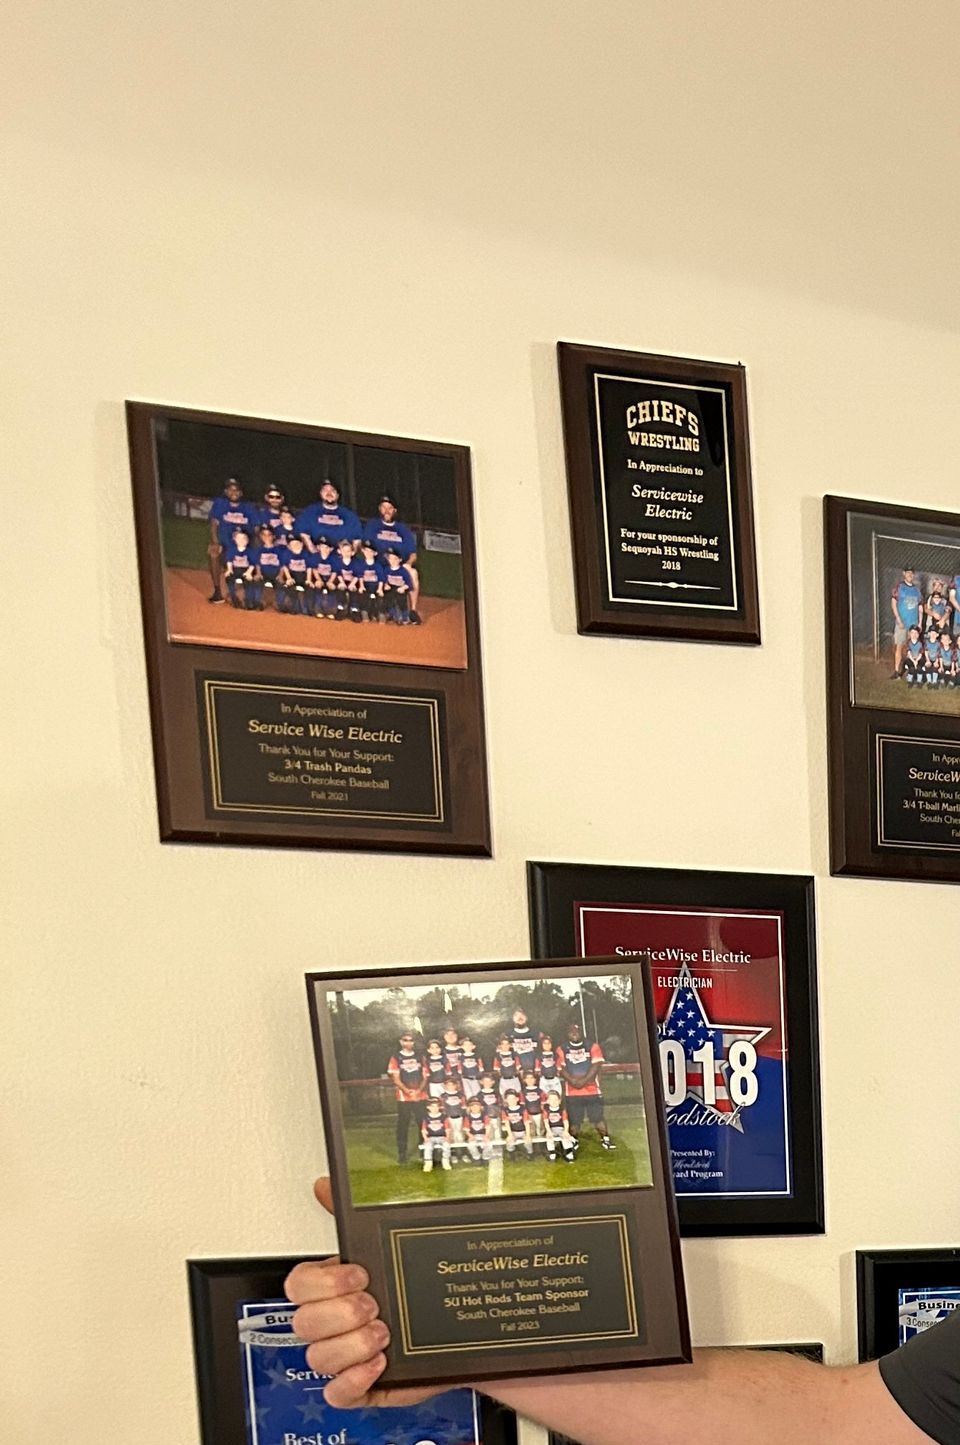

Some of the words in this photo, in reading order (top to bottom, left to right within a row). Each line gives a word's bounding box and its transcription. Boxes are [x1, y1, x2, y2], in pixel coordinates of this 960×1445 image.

[626, 400, 699, 436] CHIEFS
[628, 431, 699, 452] WRESTLING
[627, 459, 637, 468] In
[639, 460, 693, 475] Appreciation
[632, 484, 703, 503] Servicewise
[645, 504, 692, 520] Electric
[620, 528, 636, 538] For
[637, 531, 656, 540] your
[658, 532, 707, 546] sponsorship
[709, 537, 718, 545] of
[621, 543, 662, 555] Sequoyah
[664, 546, 677, 556] HS
[679, 548, 719, 561] Wrestling
[662, 561, 681, 570] 2018
[281, 703, 292, 713] In
[294, 704, 354, 719] Appreciation
[357, 710, 367, 719] of
[249, 720, 304, 736] Service
[309, 724, 343, 739] Wise
[349, 727, 402, 743] Electric
[259, 743, 290, 754] Thank
[293, 746, 311, 757] You
[313, 747, 326, 757] for
[329, 748, 350, 759] Your
[353, 750, 394, 763] Support:
[932, 753, 940, 762] In
[284, 760, 301, 770] 3/4
[305, 761, 332, 771] Trash
[335, 763, 371, 775] Pandas
[268, 773, 298, 784] South
[301, 775, 347, 786] Cherokee
[350, 778, 389, 789] Baseball
[311, 791, 326, 800] Fall
[328, 792, 348, 801] 2021
[914, 788, 938, 799] Thank
[939, 790, 952, 800] You
[903, 800, 916, 808] 3/4
[918, 801, 940, 810] T-ball
[920, 814, 942, 822] South
[615, 947, 698, 961] ServiceWise
[702, 950, 750, 963] Electric
[658, 976, 712, 988] ELECTRICIAN
[659, 1040, 758, 1106] 018
[667, 1102, 744, 1125] odstock
[691, 1171, 723, 1179] Program
[467, 1241, 478, 1250] In
[480, 1237, 542, 1251] Appreciation
[544, 1235, 554, 1245] of
[437, 1256, 529, 1274] ServiceWise
[533, 1252, 588, 1267] Electric
[446, 1283, 478, 1293] Thank
[480, 1281, 498, 1290] You
[501, 1279, 514, 1289] for
[517, 1278, 539, 1288] Your
[542, 1276, 584, 1287] Support:
[462, 1296, 483, 1306] Hot
[485, 1294, 511, 1304] Rods
[514, 1292, 543, 1302] Team
[545, 1289, 588, 1301] Sponsor
[456, 1310, 487, 1320] South
[489, 1307, 536, 1318] Cherokee
[539, 1303, 580, 1314] Baseball
[500, 1322, 515, 1331] Fall
[517, 1321, 540, 1330] 2023
[907, 1317, 910, 1325] 3
[328, 1429, 347, 1445] of
